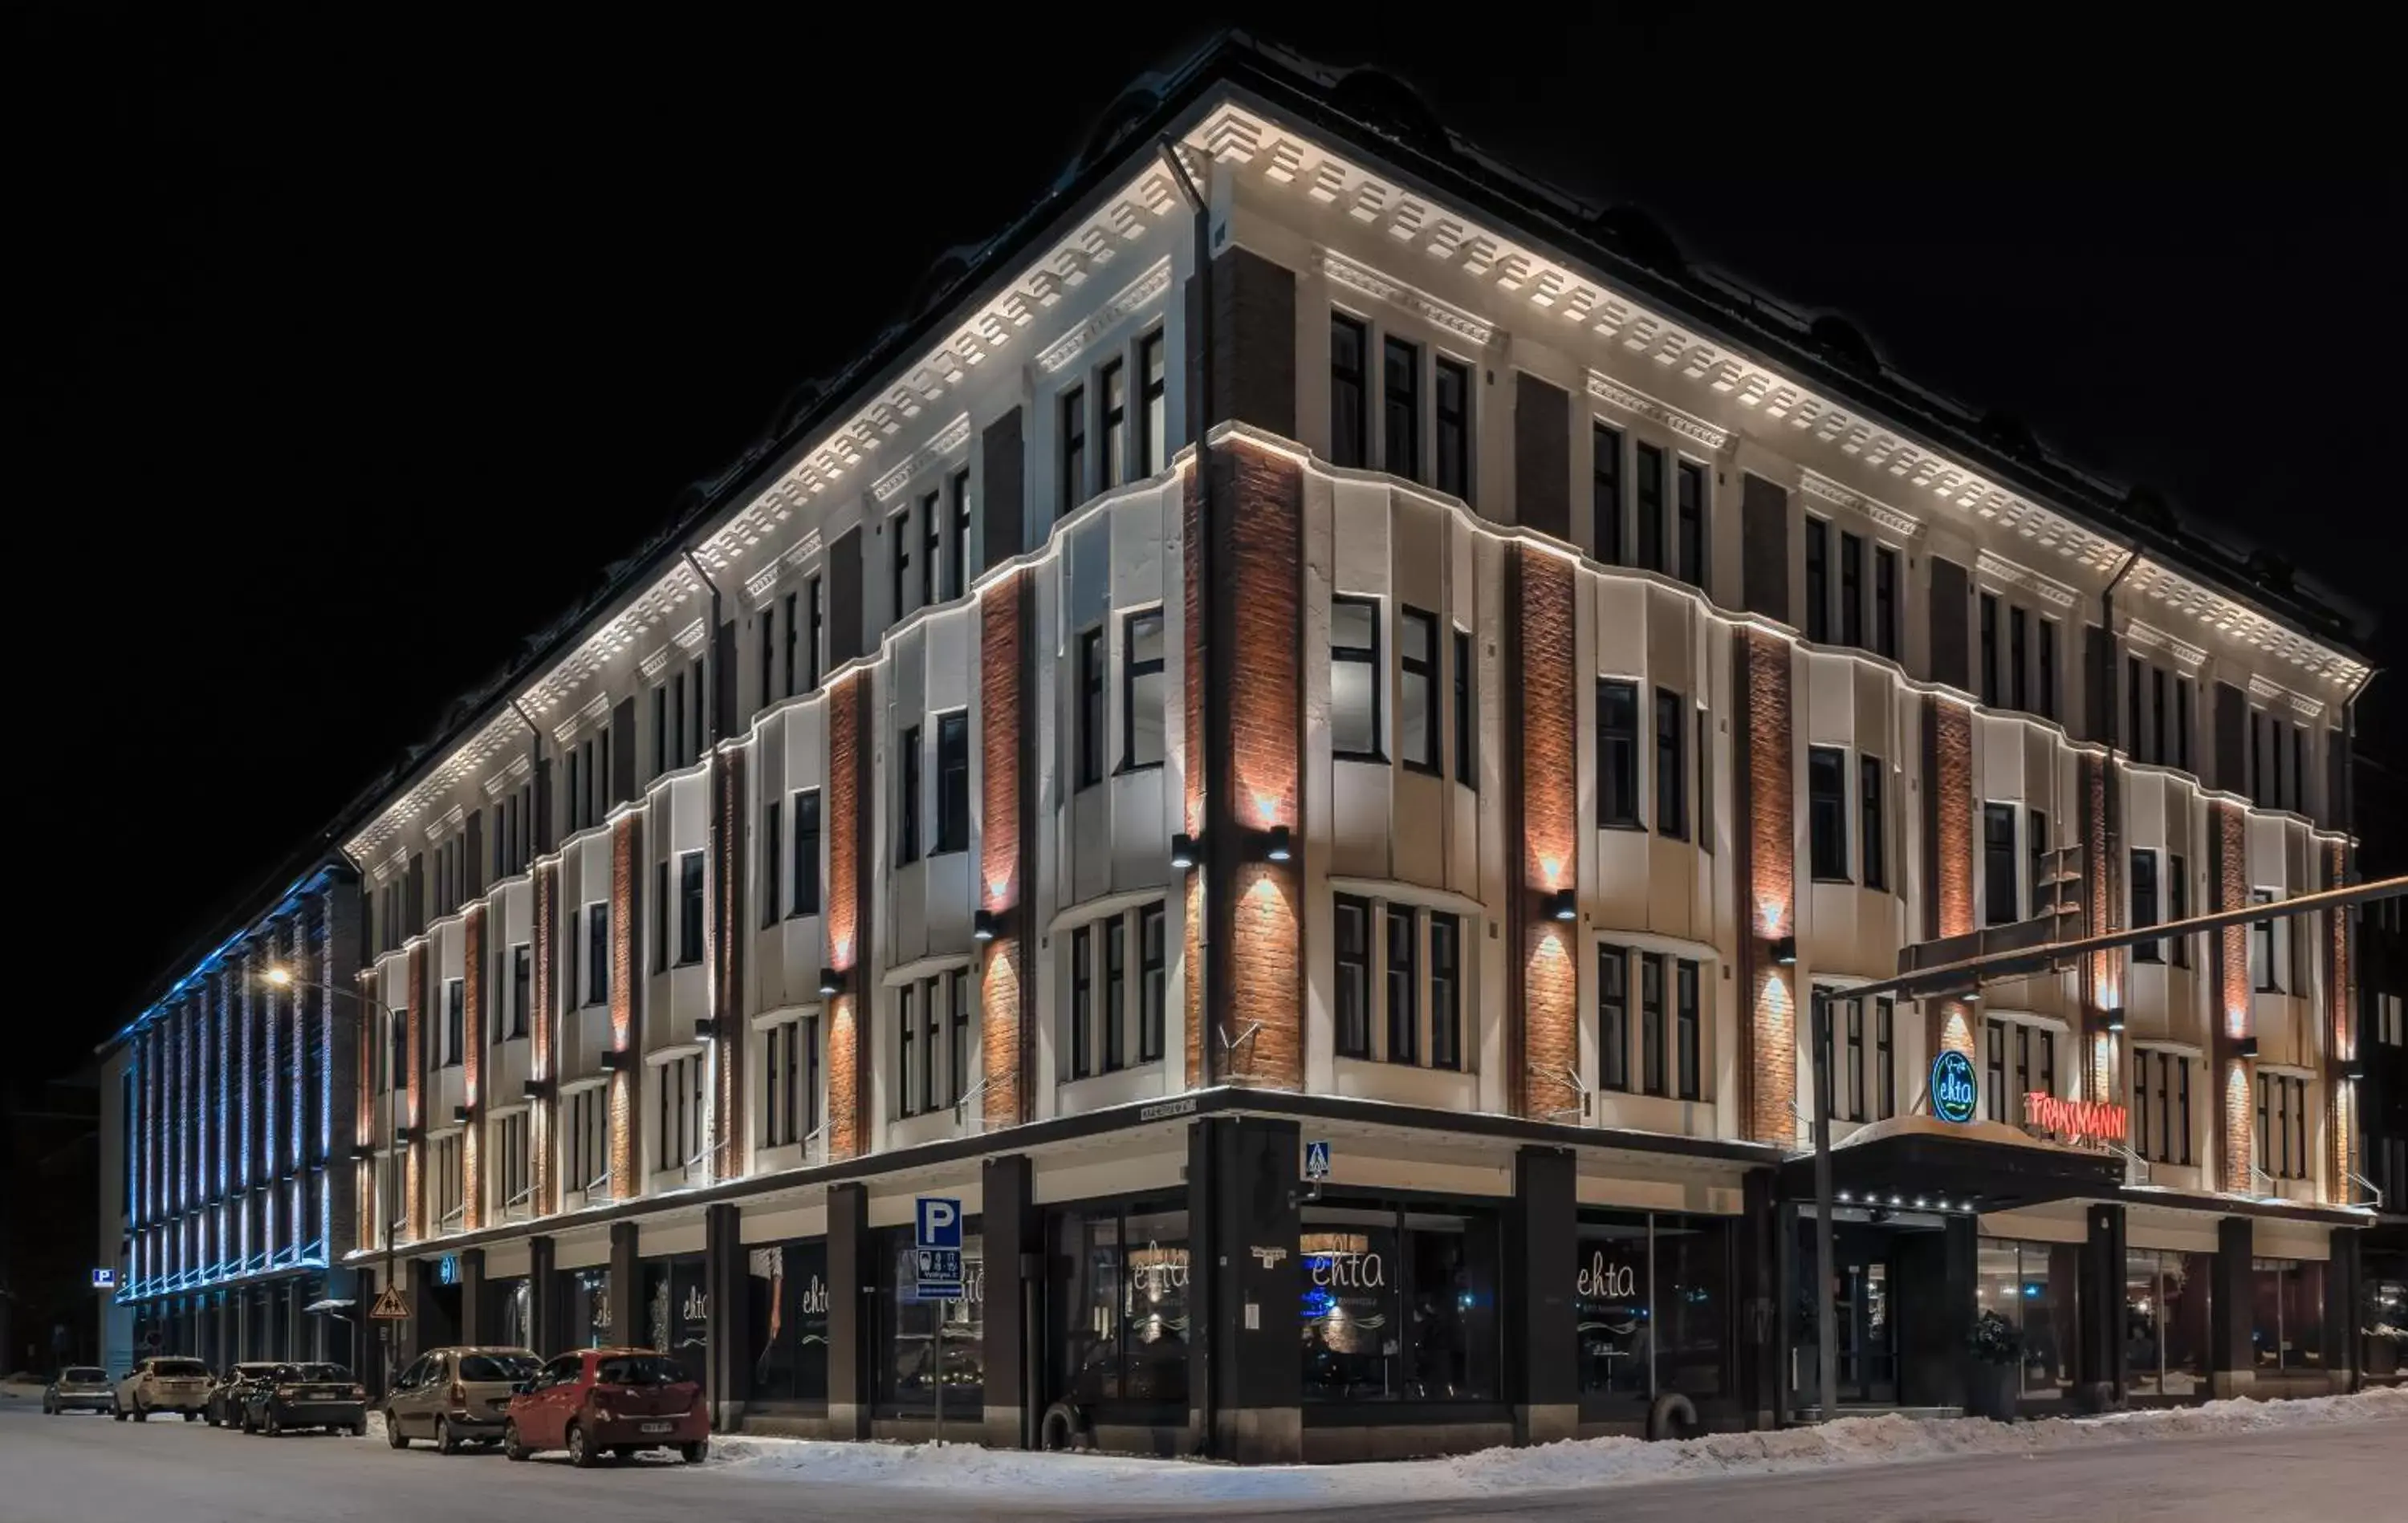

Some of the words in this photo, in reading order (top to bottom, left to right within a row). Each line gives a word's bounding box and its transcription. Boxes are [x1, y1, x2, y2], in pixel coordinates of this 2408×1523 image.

[925, 1201, 954, 1244] P
[99, 1270, 110, 1281] P
[1312, 1235, 1385, 1288] ehta
[1577, 1251, 1635, 1297] ehta
